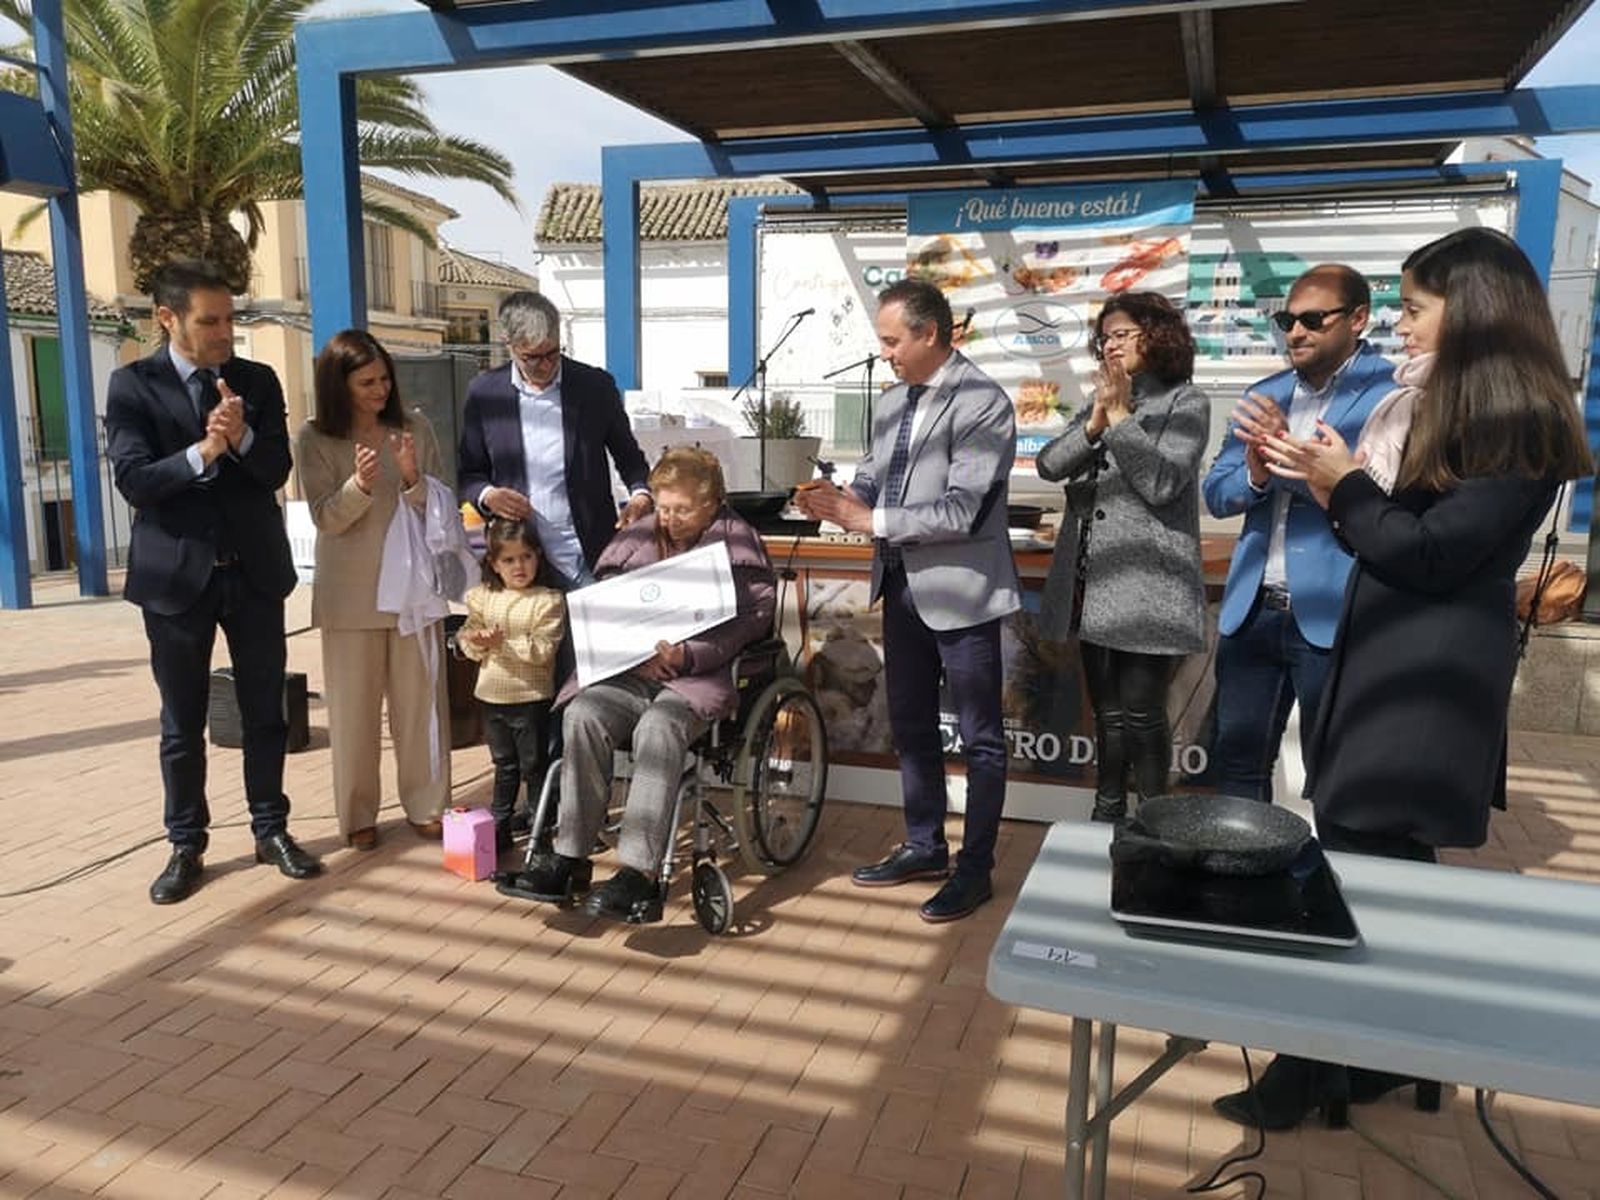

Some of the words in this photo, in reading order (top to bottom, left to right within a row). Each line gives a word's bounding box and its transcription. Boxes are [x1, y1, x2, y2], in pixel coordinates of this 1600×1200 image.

[955, 196, 1007, 228] ¡Qué
[1011, 197, 1076, 219] bueno
[1080, 191, 1142, 216] está!
